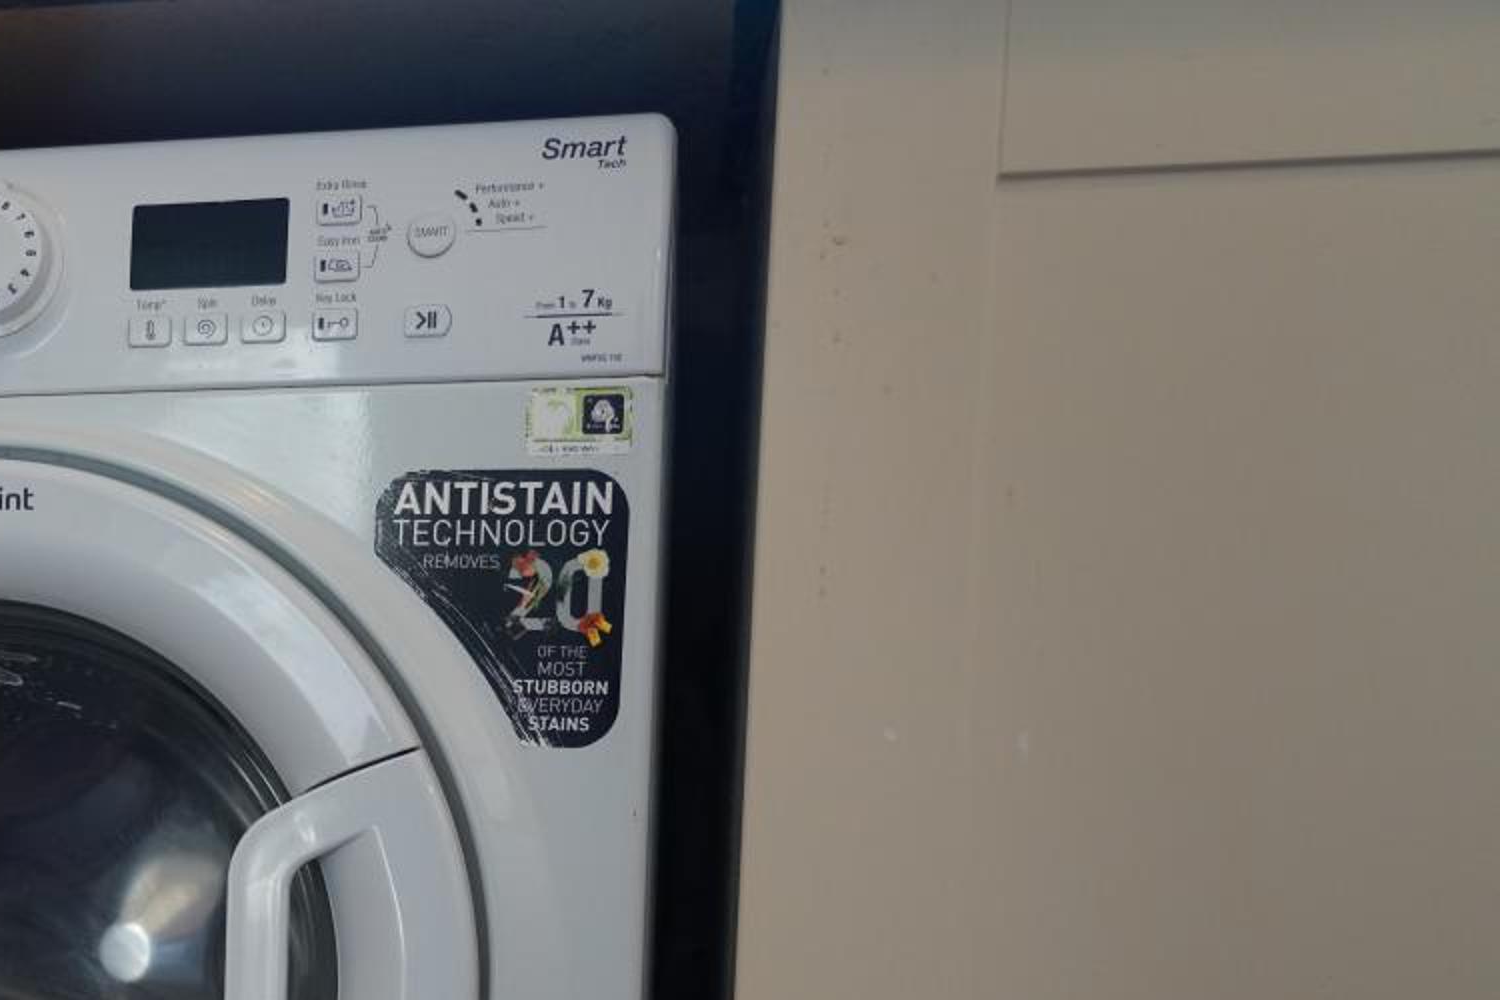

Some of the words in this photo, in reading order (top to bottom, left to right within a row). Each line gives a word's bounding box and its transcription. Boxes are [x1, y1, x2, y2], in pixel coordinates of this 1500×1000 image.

[541, 136, 628, 161] Smart
[598, 159, 628, 170] Tech
[414, 226, 449, 238] SMART
[581, 289, 595, 308] 7
[548, 320, 596, 346] A++
[393, 480, 614, 515] ANTISTAIN
[392, 518, 612, 547] TECHNOLOGY
[423, 555, 501, 570] REMOVES
[503, 549, 612, 646] 20
[537, 644, 557, 658] OF
[560, 645, 588, 659] THE
[537, 661, 588, 677] MOST
[513, 679, 609, 695] STUBBORN
[518, 697, 604, 714] EVERYDAY
[528, 715, 590, 732] STAINS
